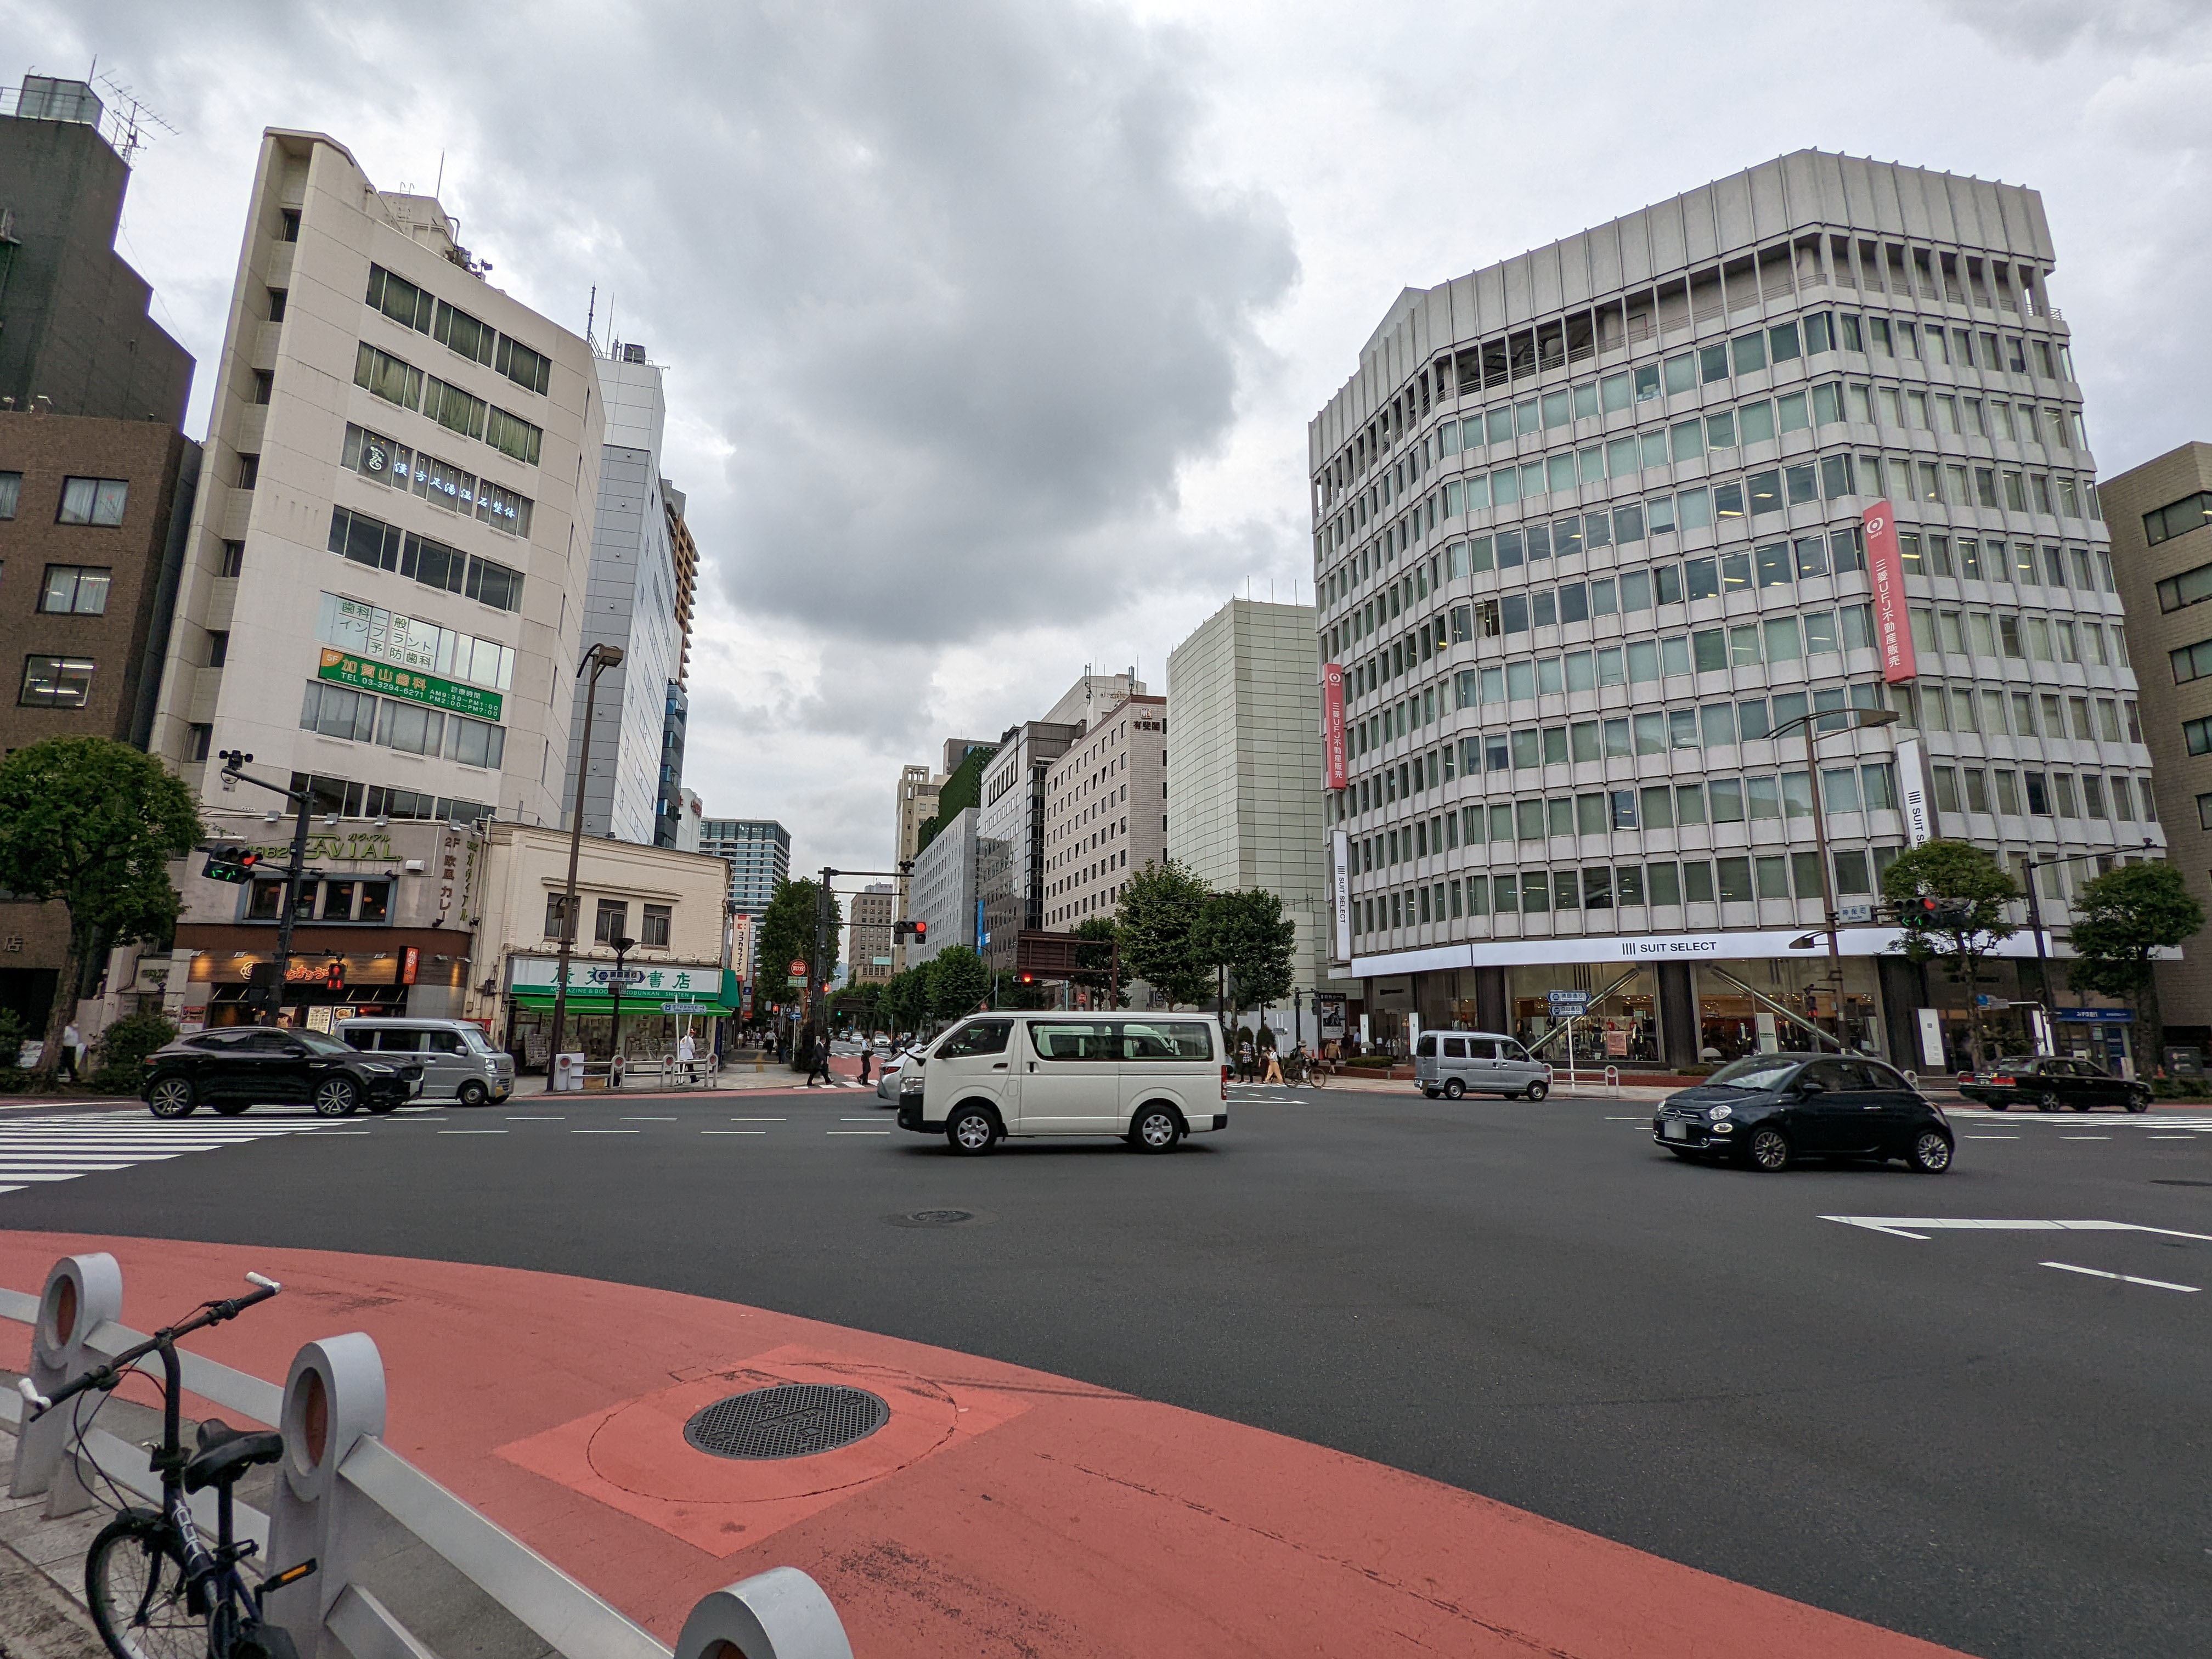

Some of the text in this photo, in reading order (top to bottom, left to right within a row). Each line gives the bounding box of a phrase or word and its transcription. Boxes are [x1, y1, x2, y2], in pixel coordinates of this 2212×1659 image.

[1876, 558, 1901, 668] 三菱UFJ不動産販売
[340, 620, 431, 652] インプラント
[326, 653, 338, 662] 5F
[370, 641, 431, 668] 予防歯科
[341, 658, 427, 692] 加賀山歯科
[341, 672, 424, 698] TEL 03-3294-6271
[450, 686, 481, 700] 診療時間
[1133, 720, 1160, 731] 有斐閣
[1332, 702, 1343, 779] 三菱UFJ不動産販売
[1912, 807, 1924, 832] SUIT
[348, 833, 391, 842] ガヴィアル
[444, 837, 461, 848] 2F
[439, 854, 457, 922] 欧風カレー
[1640, 941, 1717, 953] SUIT SELECT
